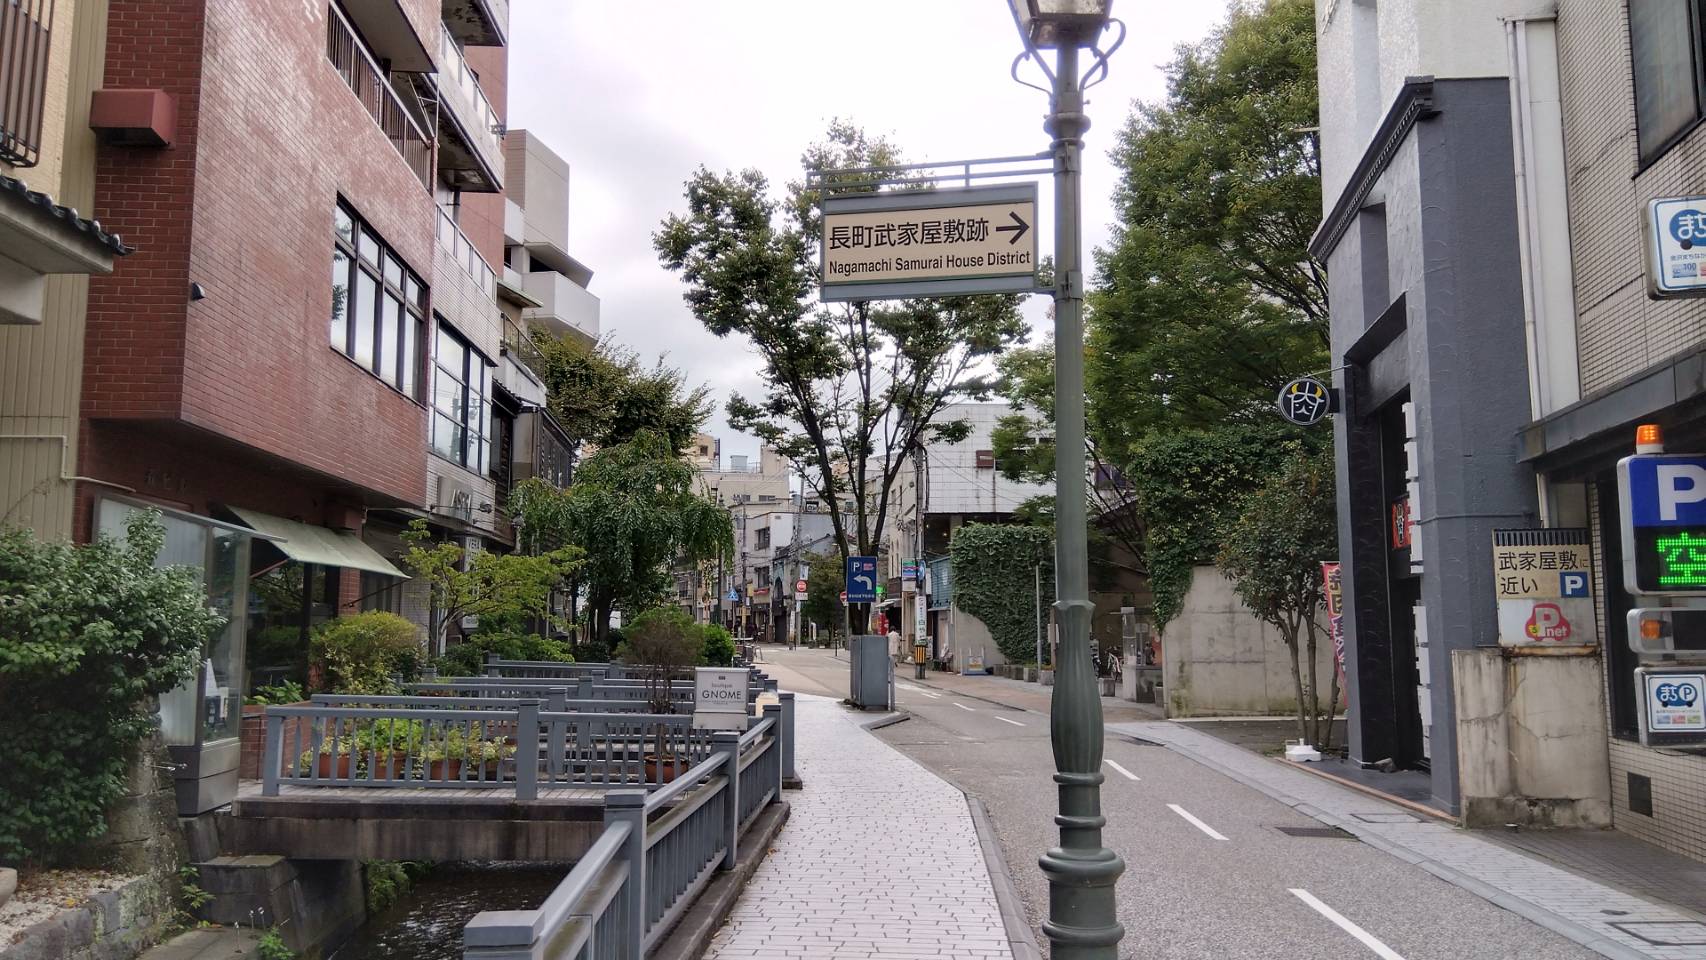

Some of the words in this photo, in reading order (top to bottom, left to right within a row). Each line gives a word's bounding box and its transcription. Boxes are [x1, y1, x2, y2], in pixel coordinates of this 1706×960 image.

[829, 217, 989, 250] 長町武家屋敷跡
[829, 258, 892, 276] Nagamachi
[895, 253, 942, 271] Samurai
[946, 254, 984, 268] House
[987, 251, 1030, 265] District
[1657, 464, 1706, 520] P
[1498, 550, 1591, 571] 武家屋敷に
[1501, 576, 1538, 595] 近い
[1565, 575, 1583, 595] P
[702, 690, 741, 700] GNOME
